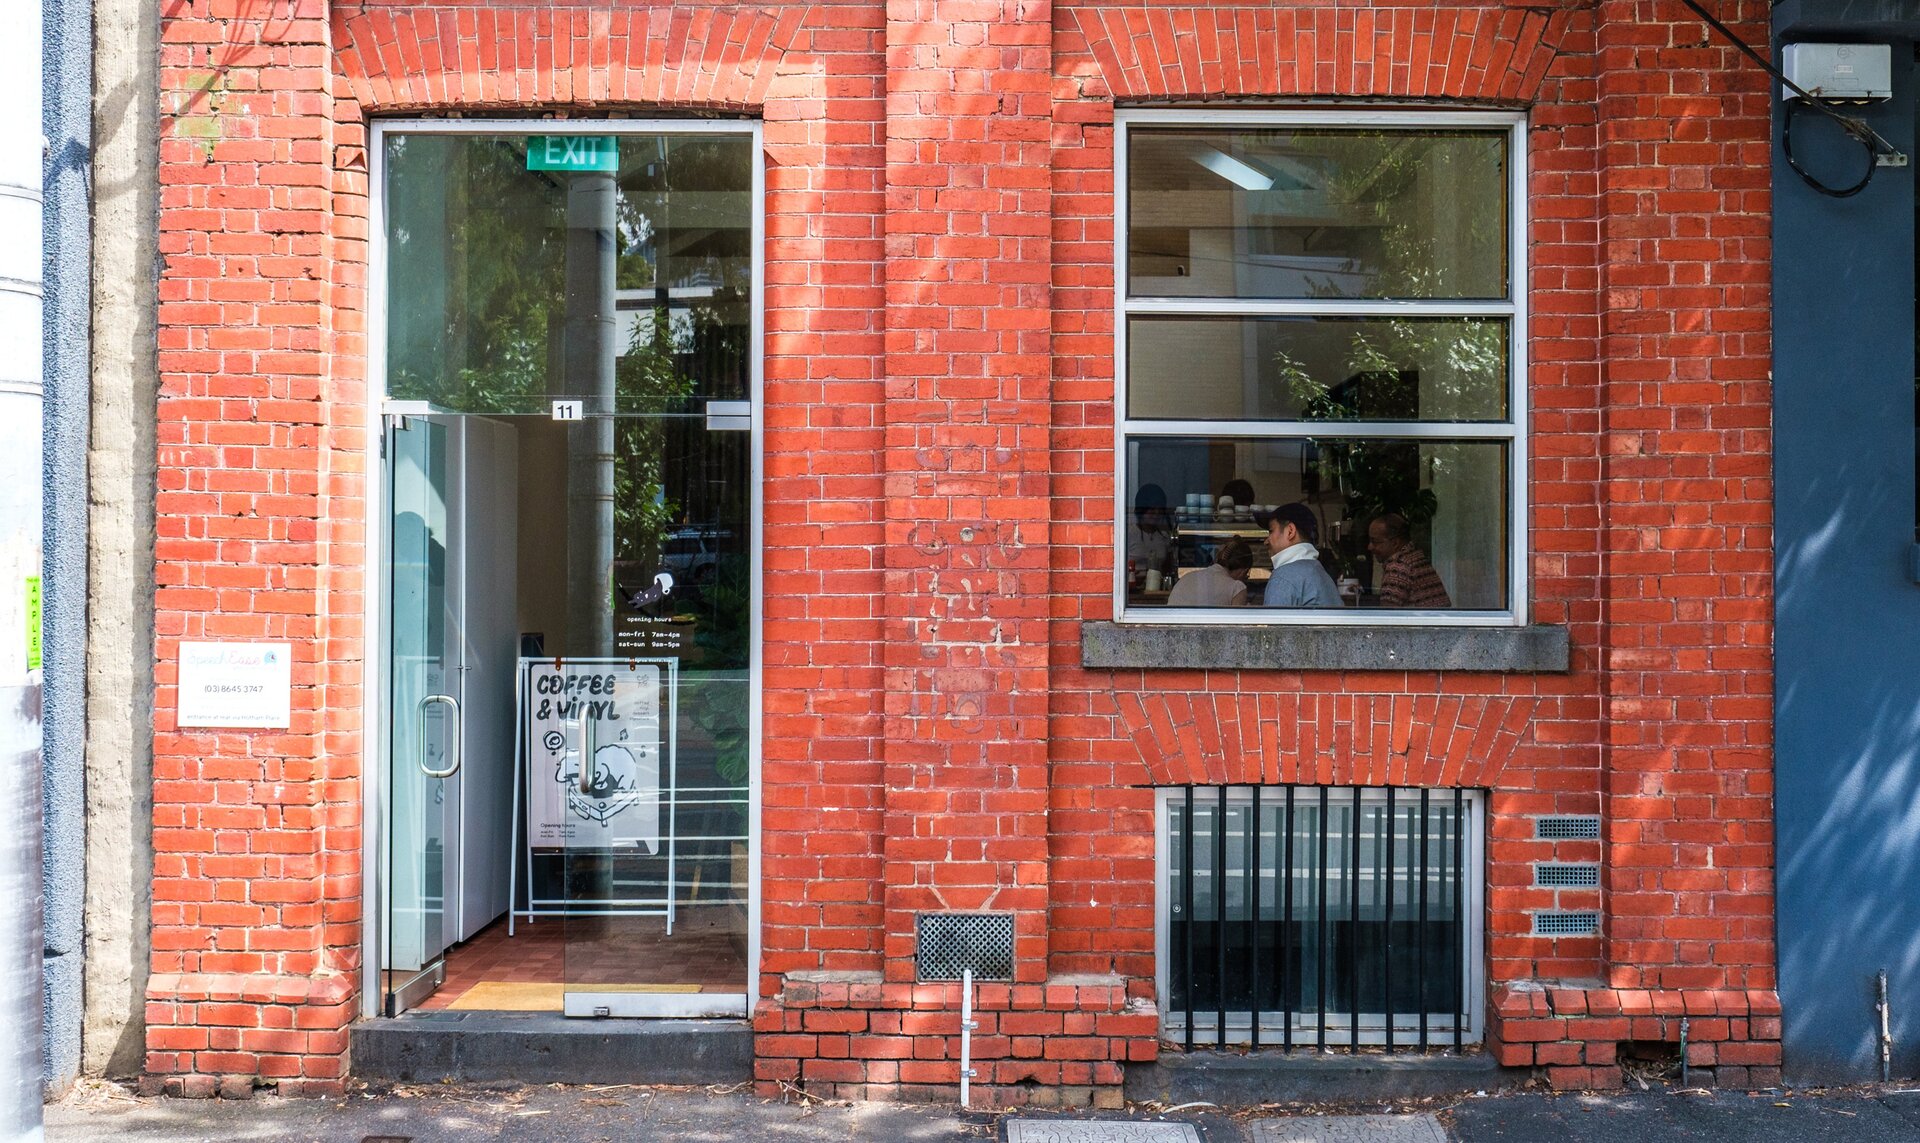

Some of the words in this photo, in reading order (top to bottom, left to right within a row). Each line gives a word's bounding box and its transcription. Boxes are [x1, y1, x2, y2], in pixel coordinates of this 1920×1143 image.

[544, 136, 602, 165] EXIT
[557, 405, 573, 419] 11
[626, 616, 652, 624] opening
[651, 631, 681, 639] 7am-4pm
[651, 641, 681, 649] 9am-5pm
[204, 684, 220, 694] (03)
[220, 684, 242, 694] 8645
[242, 684, 264, 694] 3747
[536, 674, 617, 695] COFFEE
[536, 698, 552, 721] &
